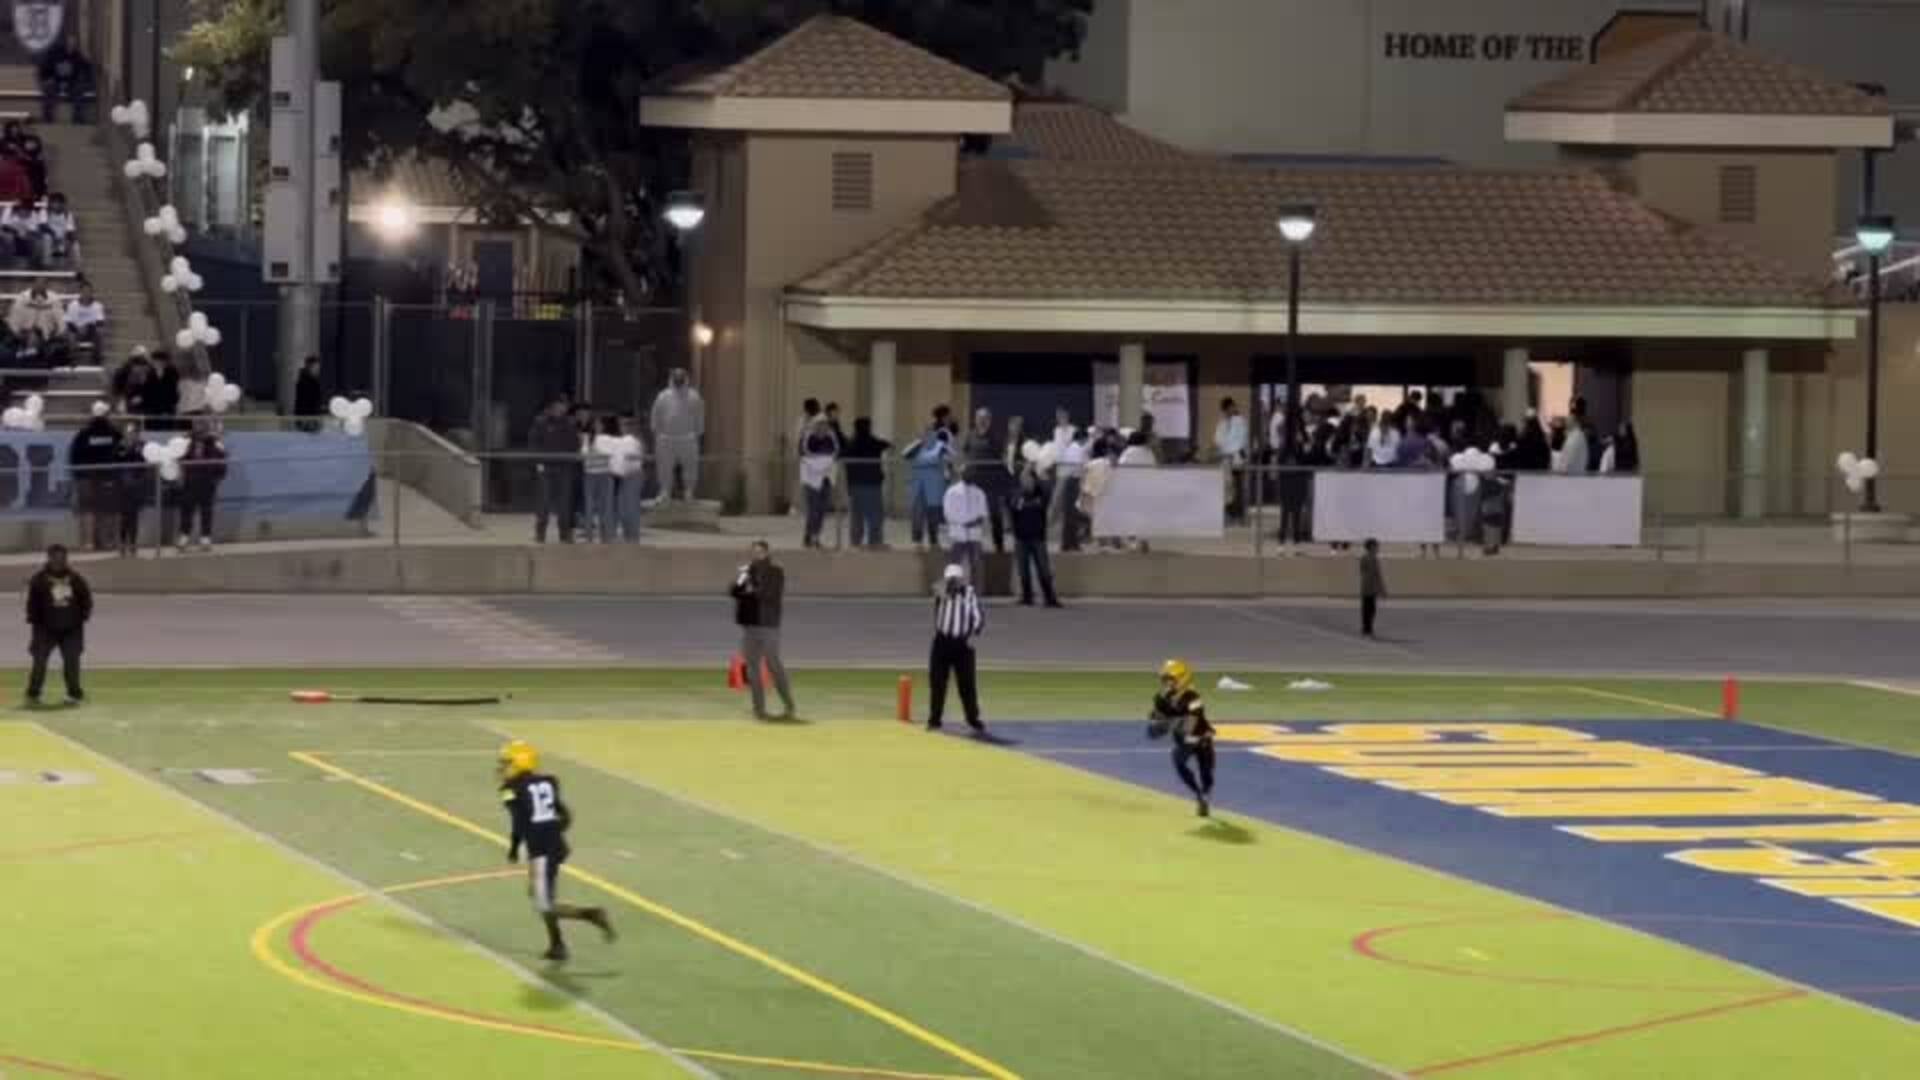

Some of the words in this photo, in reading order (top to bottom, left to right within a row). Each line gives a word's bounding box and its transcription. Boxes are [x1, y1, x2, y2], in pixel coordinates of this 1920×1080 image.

[1384, 32, 1475, 59] HOME
[1482, 34, 1520, 61] OF
[1525, 35, 1581, 61] THE
[527, 782, 556, 822] 12
